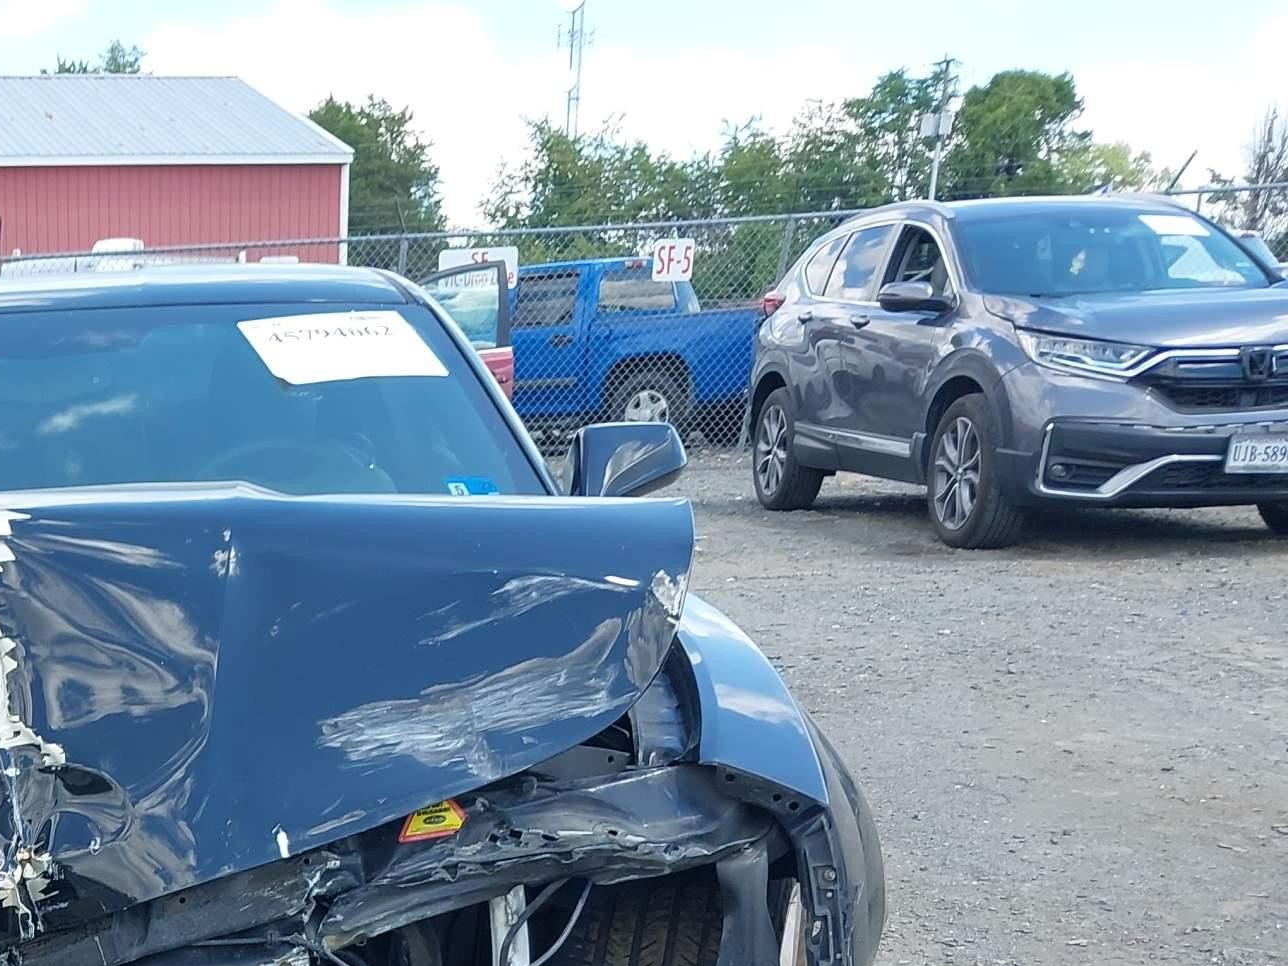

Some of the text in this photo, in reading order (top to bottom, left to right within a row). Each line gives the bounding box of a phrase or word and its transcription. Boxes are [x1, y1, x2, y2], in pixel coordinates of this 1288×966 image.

[656, 245, 692, 275] SF-5
[490, 270, 515, 285] Ze
[1232, 445, 1288, 462] UJB-589
